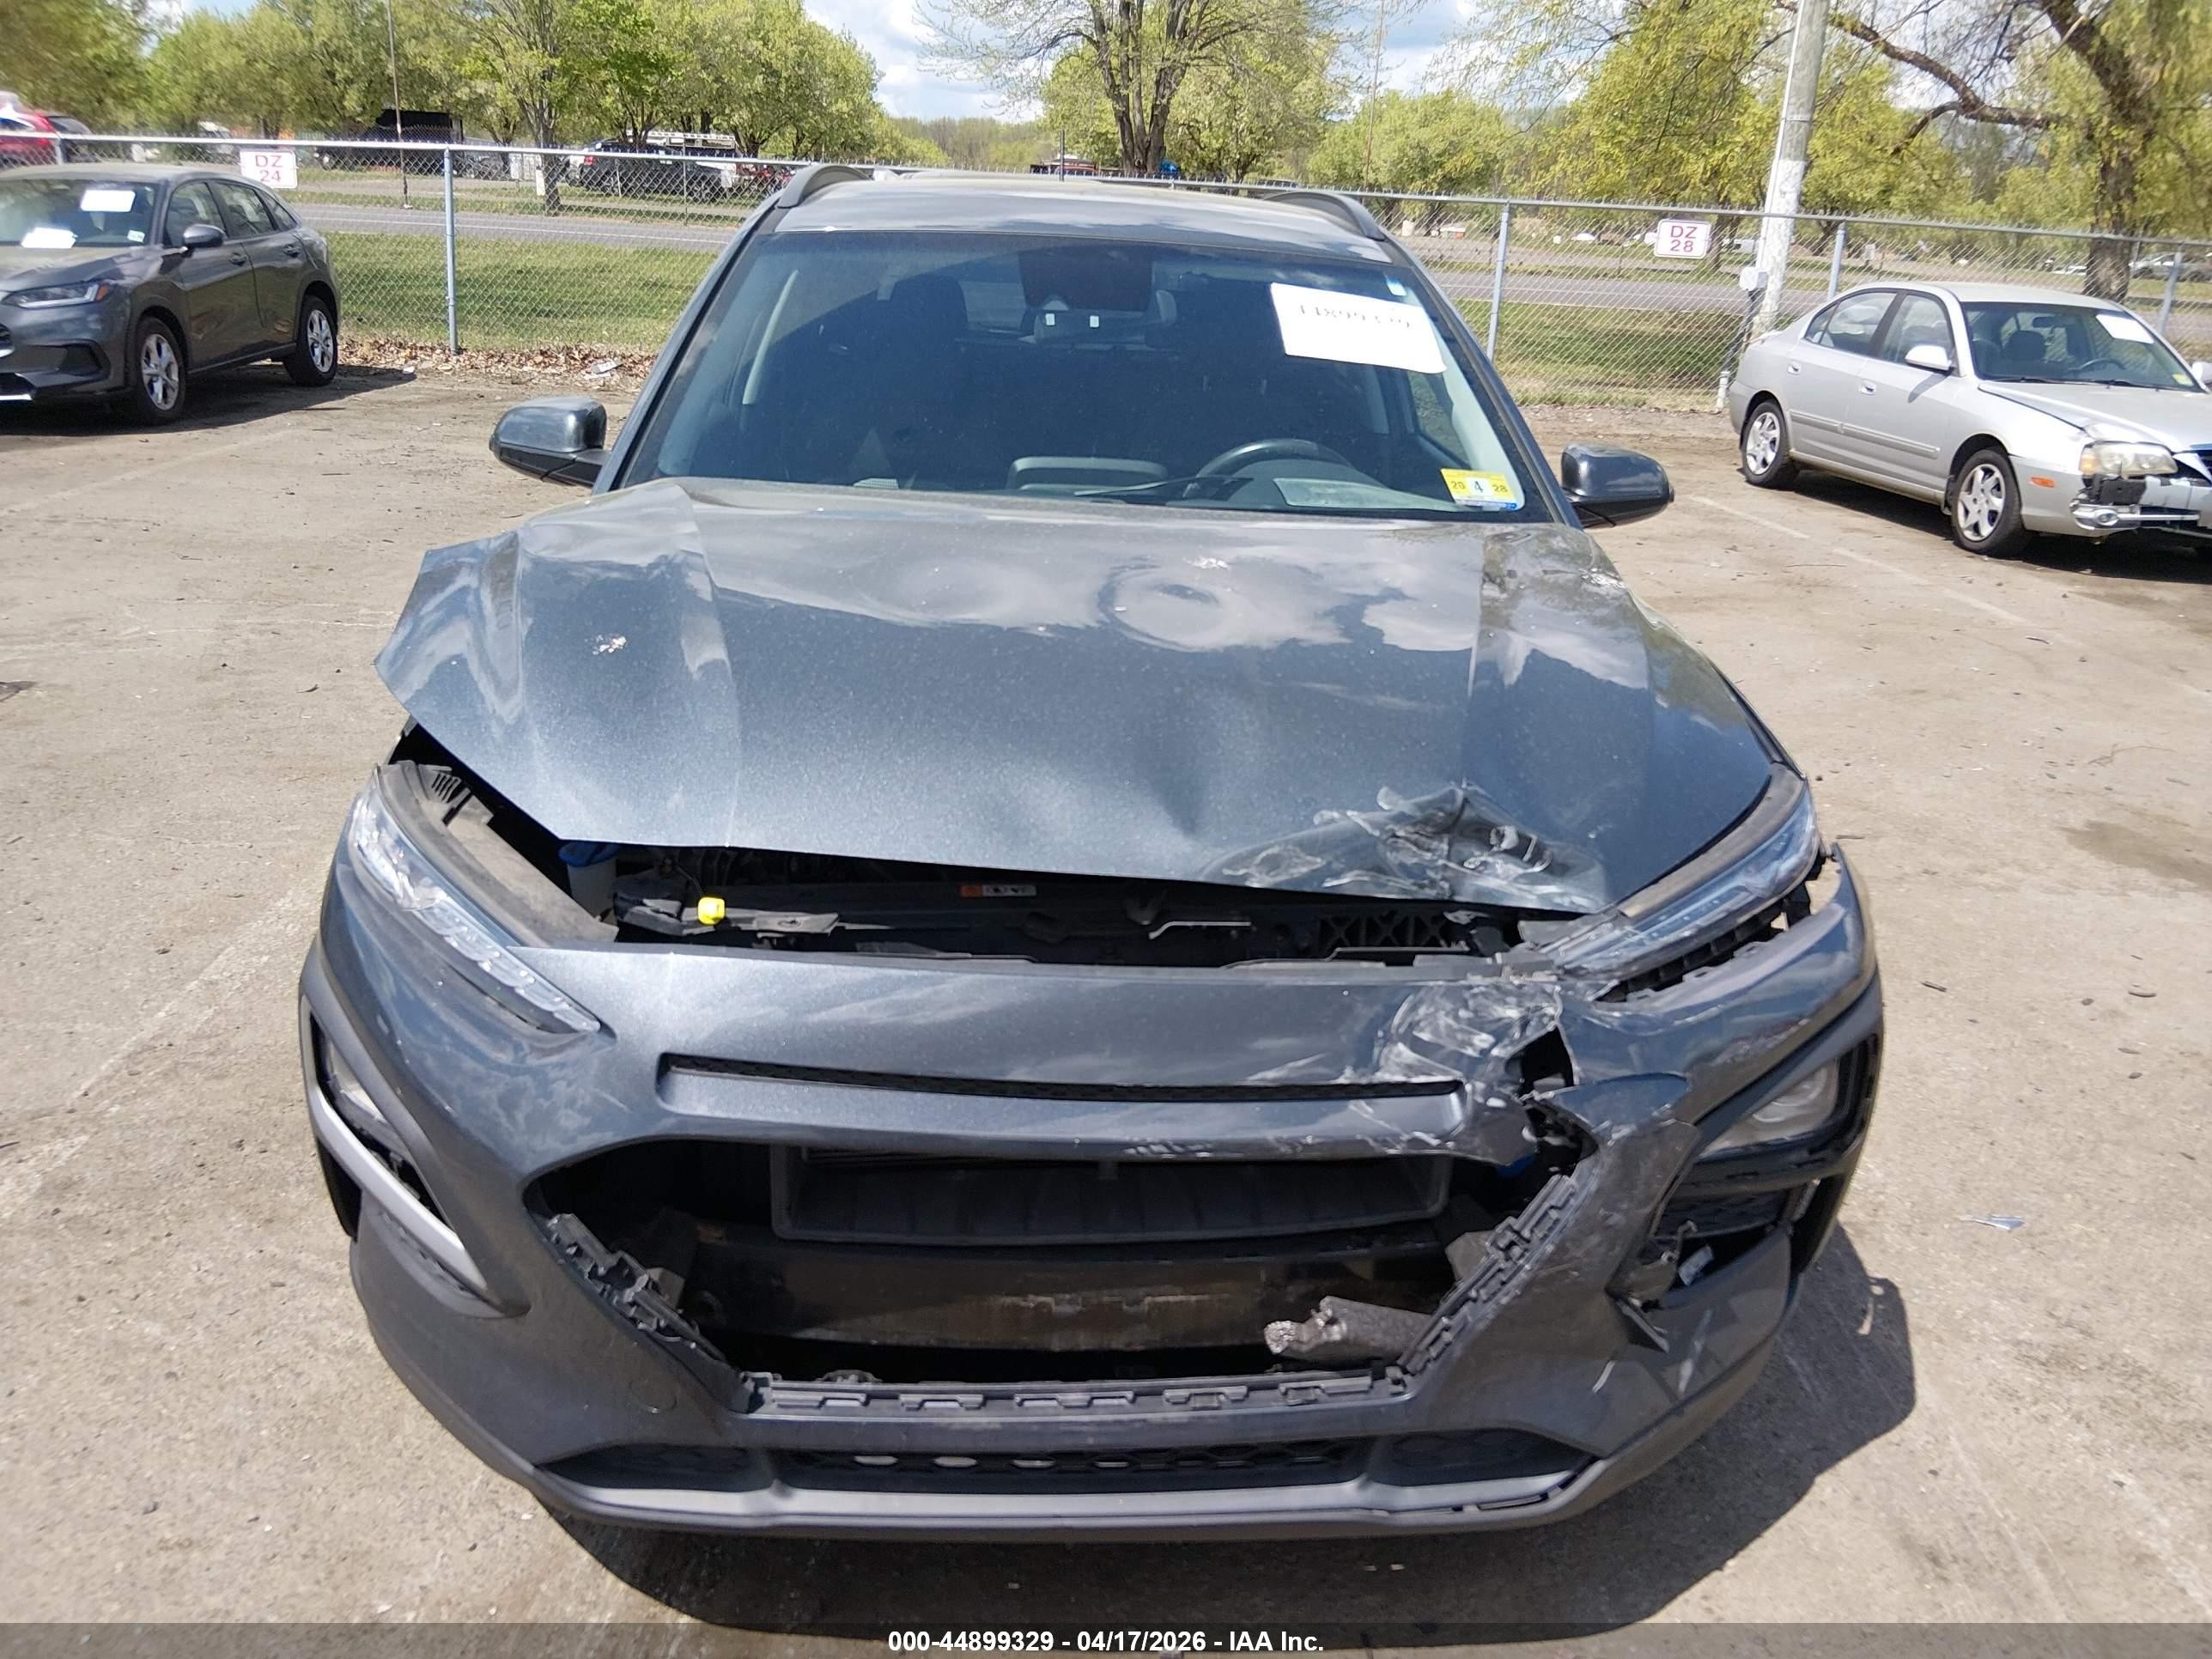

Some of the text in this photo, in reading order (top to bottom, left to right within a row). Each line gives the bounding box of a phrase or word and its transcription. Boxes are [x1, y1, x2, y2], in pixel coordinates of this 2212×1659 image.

[255, 155, 283, 167] DZ
[260, 169, 282, 183] 24
[1670, 225, 1698, 239] DZ
[1670, 239, 1693, 252] 28
[1474, 480, 1484, 493] 4
